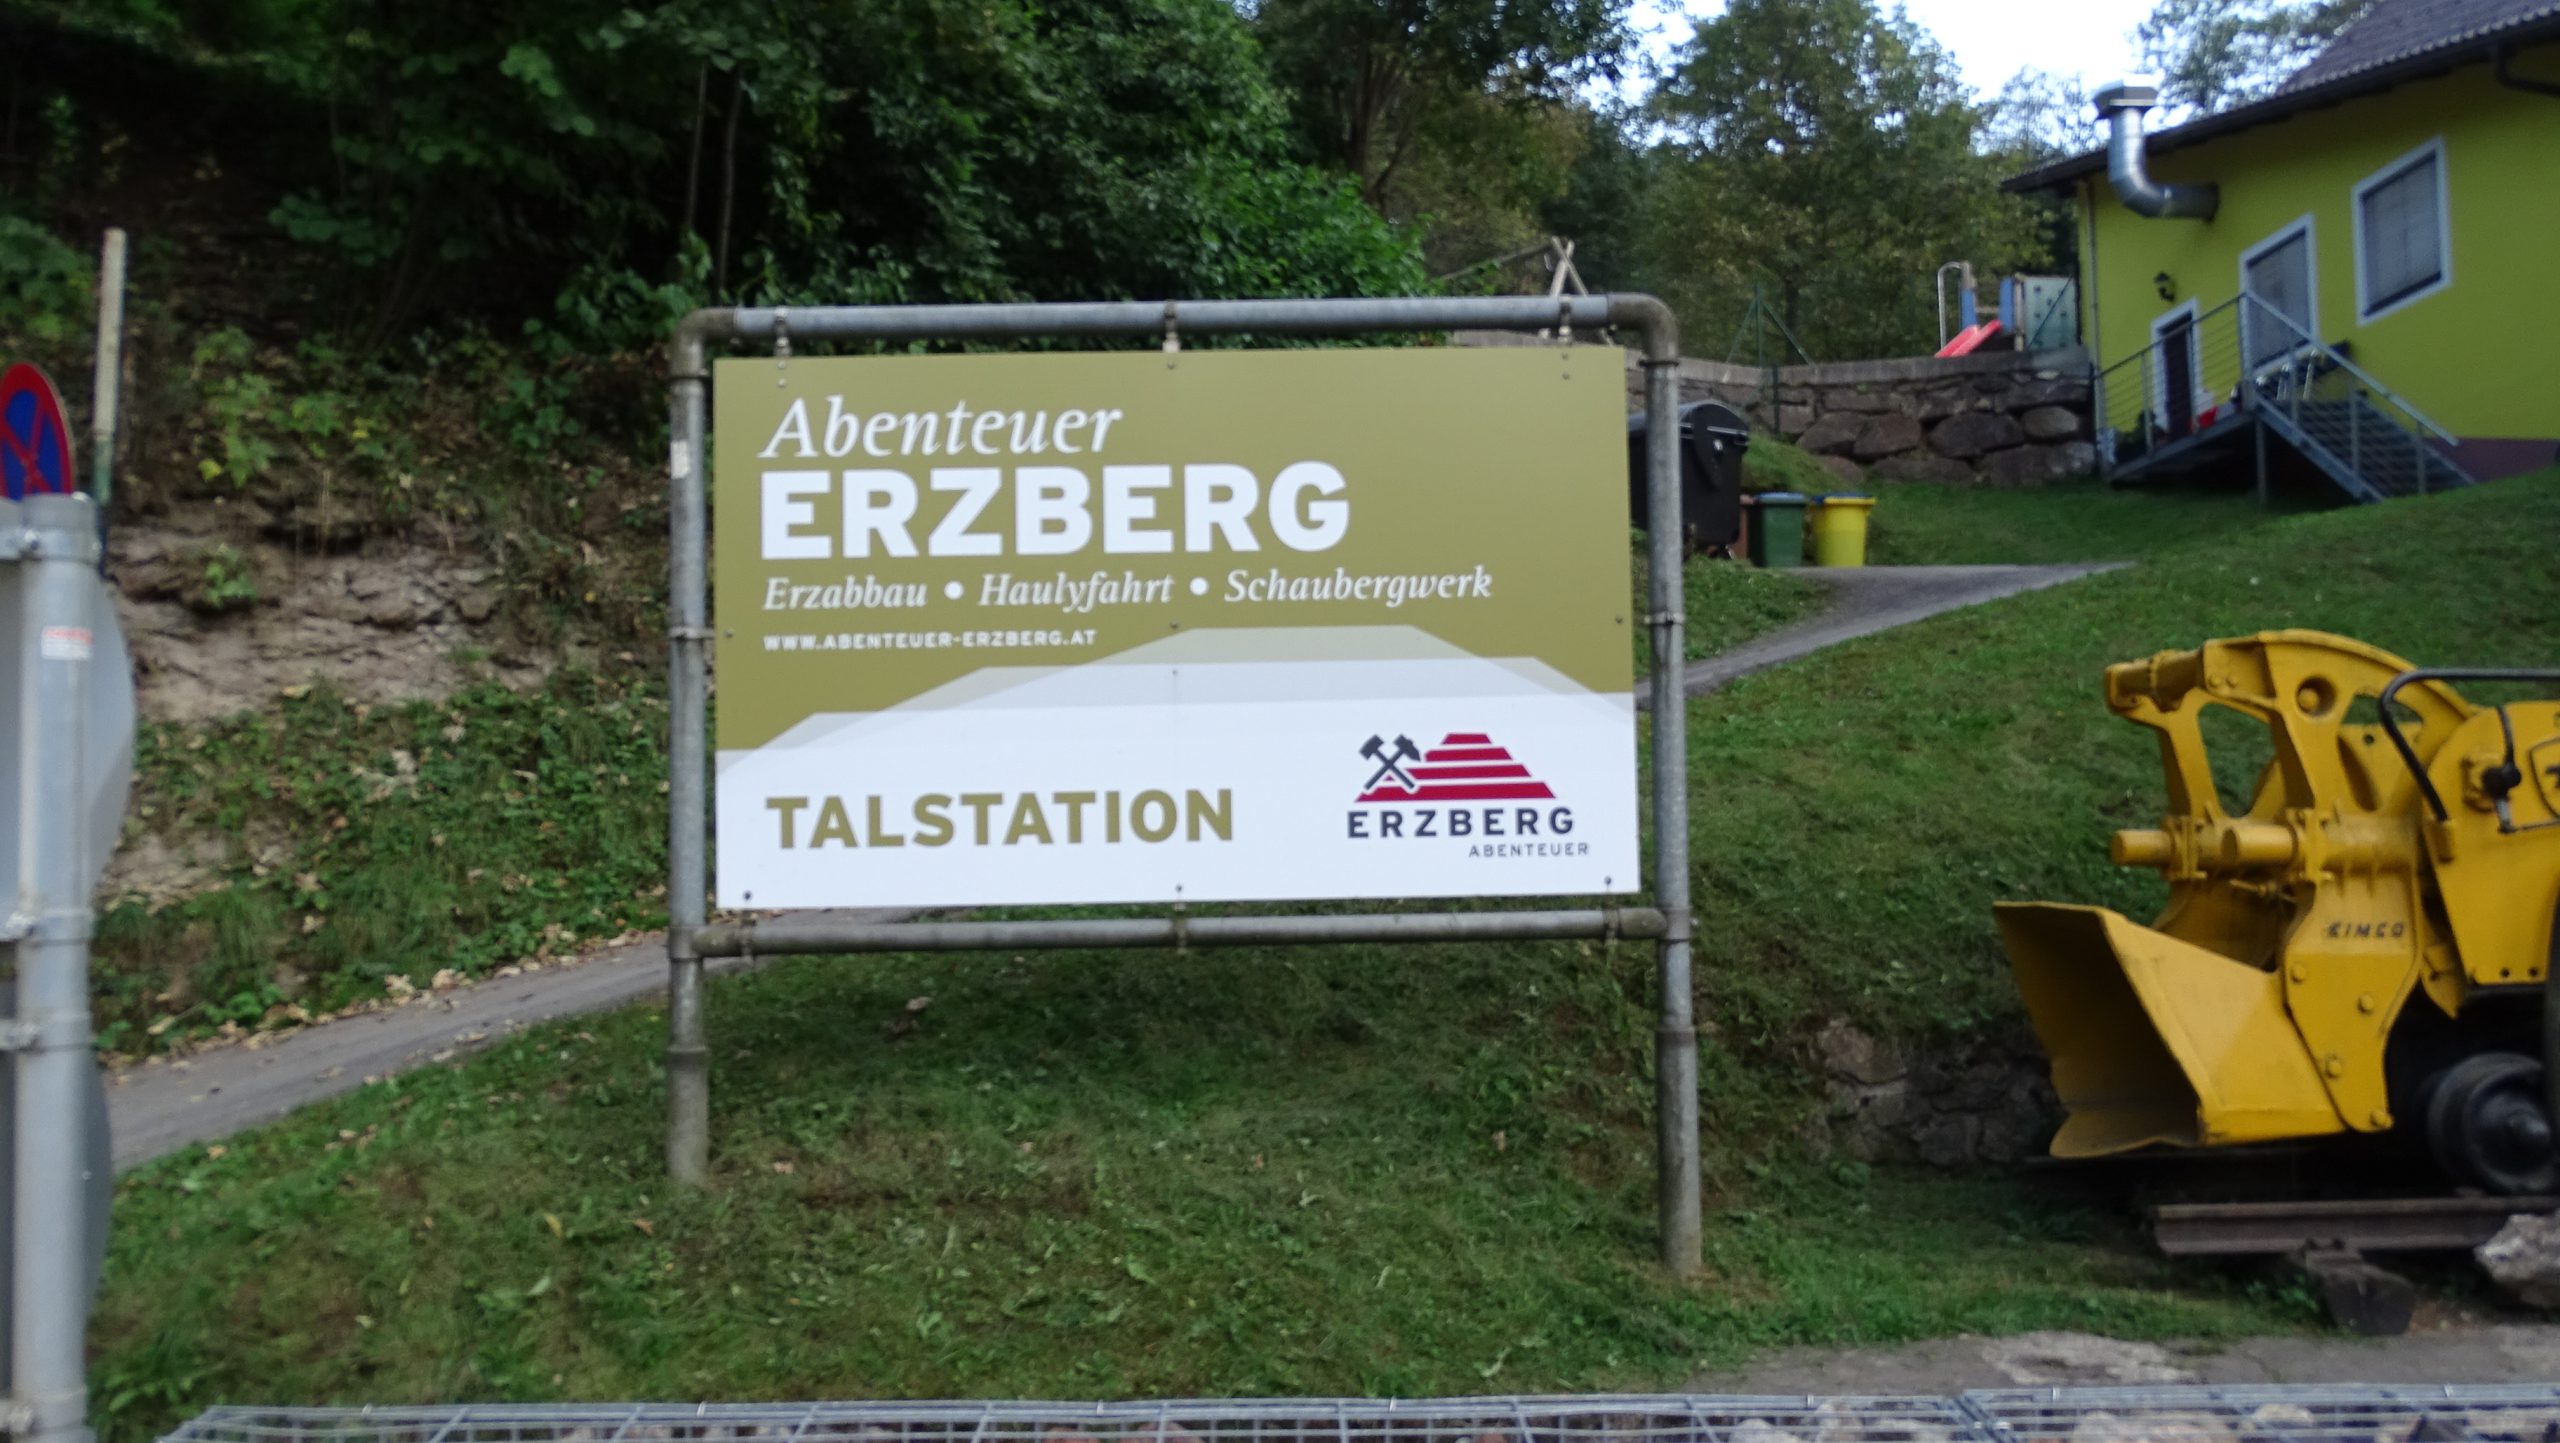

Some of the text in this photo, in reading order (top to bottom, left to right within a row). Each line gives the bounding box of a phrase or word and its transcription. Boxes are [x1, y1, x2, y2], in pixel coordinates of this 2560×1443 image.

[756, 394, 1123, 458] Abenteuer
[761, 460, 1349, 560] ERZBERG
[763, 564, 1493, 613] Erzabbau Haulyfahrt Schaubergwerk
[763, 629, 1096, 651] WWW.ABENTEUER-ERZBERG.AT
[765, 788, 1233, 849] TALSTATION
[1347, 807, 1574, 838] ERZBERG
[1468, 842, 1590, 858] ABENTEUER
